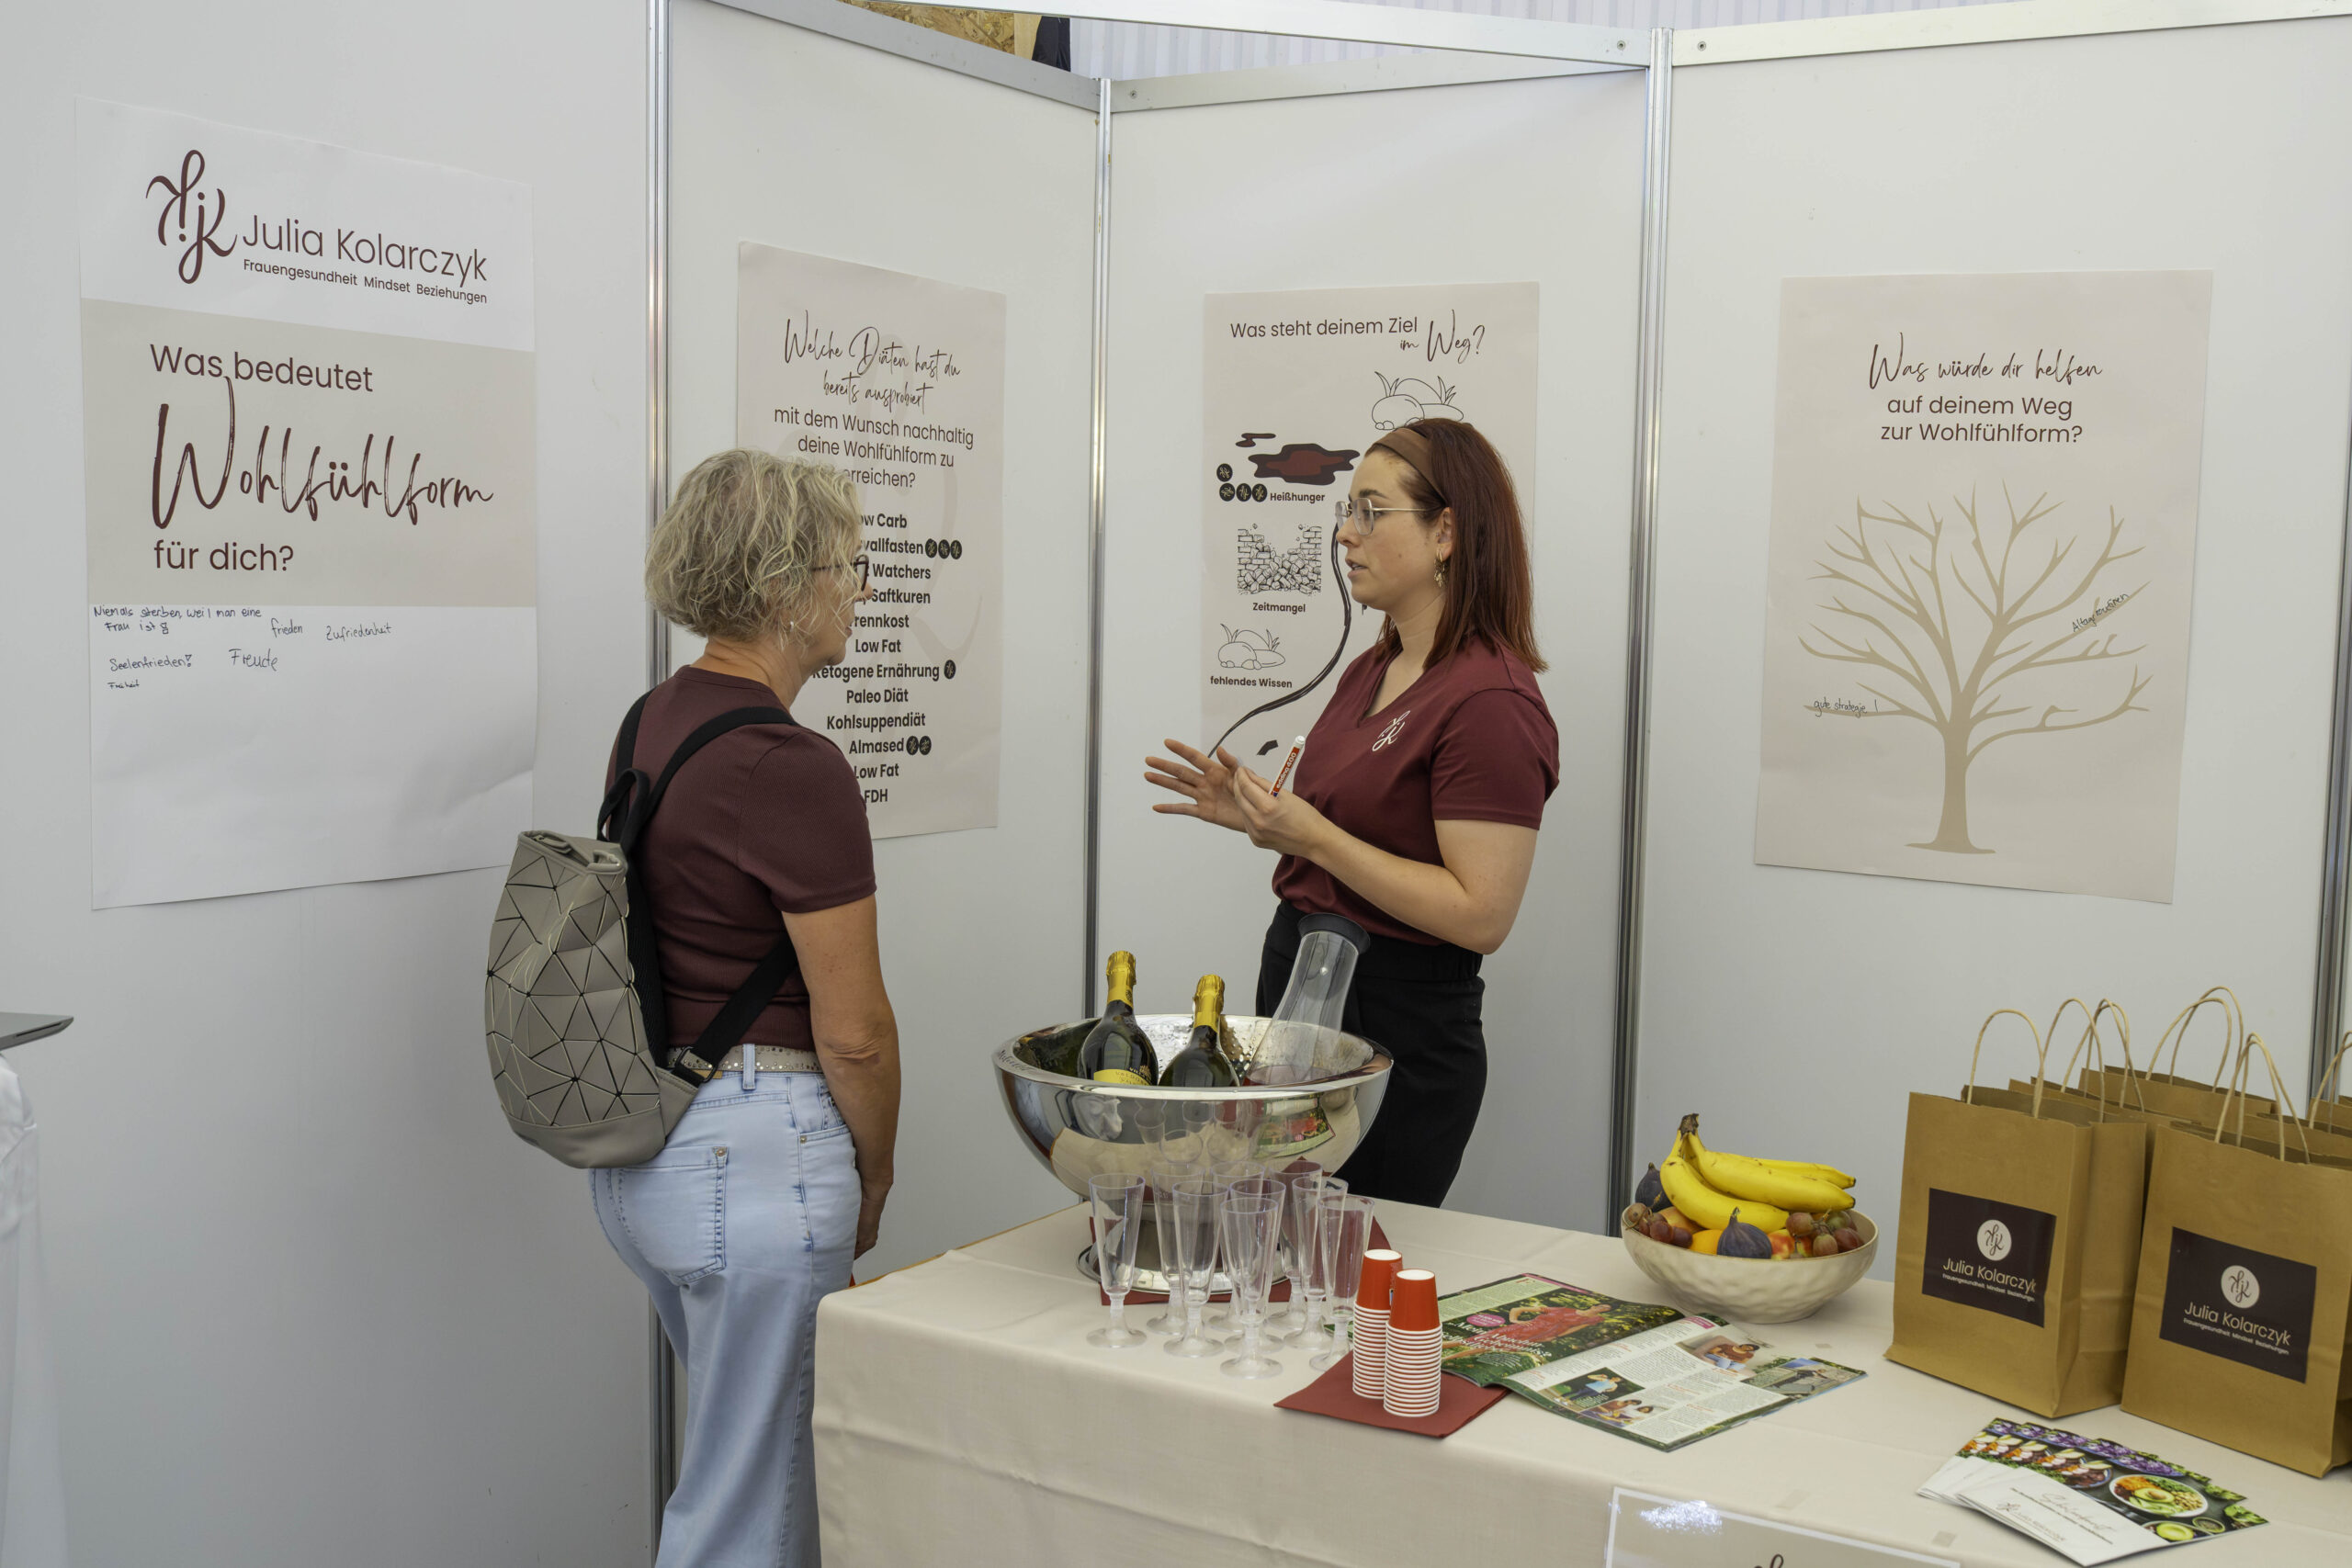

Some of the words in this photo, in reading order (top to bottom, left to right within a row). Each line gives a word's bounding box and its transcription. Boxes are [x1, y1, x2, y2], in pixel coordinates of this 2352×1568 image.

[243, 215, 322, 256] Julia
[338, 229, 487, 288] Kolarczyk
[243, 259, 357, 286] Frauengesundheit
[365, 276, 410, 292] Mindset
[416, 284, 487, 304] Beziehungen
[1230, 322, 1266, 338] Was
[1271, 321, 1312, 337] steht
[1317, 319, 1383, 335] deinem
[1388, 316, 1417, 333] Ziel
[1400, 339, 1419, 351] im
[1427, 309, 1486, 365] Weg?
[785, 310, 842, 364] Welche
[849, 326, 909, 376] Diäten
[915, 344, 947, 381] hast
[944, 355, 961, 377] du
[151, 344, 223, 378] Was
[235, 351, 373, 391] bedeutet
[1870, 332, 1928, 389] Was
[1939, 353, 1994, 378] würde
[2001, 353, 2023, 378] dir
[2036, 348, 2103, 385] helfen
[823, 369, 861, 405] bereits
[865, 381, 934, 414] ausprobiert
[1887, 395, 1922, 413] auf
[1929, 396, 2013, 414] deinem
[2022, 397, 2072, 421] Weg
[775, 407, 799, 424] mit
[804, 409, 838, 429] dem
[842, 414, 899, 436] Wunsch
[903, 423, 974, 450] nachhaltig
[1881, 425, 1913, 440] zur
[1919, 423, 2083, 443] Wohlfühlform?
[152, 376, 493, 528] Wohlfühlform
[797, 435, 840, 455] deine
[843, 439, 936, 466] Wohlfühlform
[940, 454, 954, 468] zu
[1270, 492, 1326, 503] Heißhunger
[877, 513, 907, 528] Carb
[153, 540, 198, 569] für
[209, 541, 294, 571] dich?
[873, 563, 931, 579] Watchers
[872, 588, 931, 604] Saftkuren
[94, 606, 133, 617] Niemals
[187, 608, 210, 618] weil
[216, 609, 235, 617] man
[241, 608, 262, 617] eine
[1252, 603, 1306, 615] Zeitmangel
[105, 622, 130, 632] Frau
[140, 620, 156, 631] ist
[851, 614, 910, 627] rennkost
[326, 622, 392, 641] Zufriedenheit
[855, 639, 878, 653] Low
[882, 639, 901, 653] Fat
[876, 663, 940, 682] Ernährung
[1210, 676, 1257, 687] fehlendes
[1259, 677, 1292, 688] Wissen
[846, 689, 881, 704] Paleo
[884, 688, 909, 703] Diät
[827, 712, 926, 733] Kohlsuppendiät
[849, 738, 905, 754] Almased
[880, 763, 899, 778] Fat
[865, 789, 888, 803] FDH
[1943, 1258, 1973, 1277] Julia
[1977, 1265, 2037, 1294] Kolarczyk
[2185, 1302, 2219, 1323] Julia
[2222, 1312, 2291, 1346] Kolarczyk
